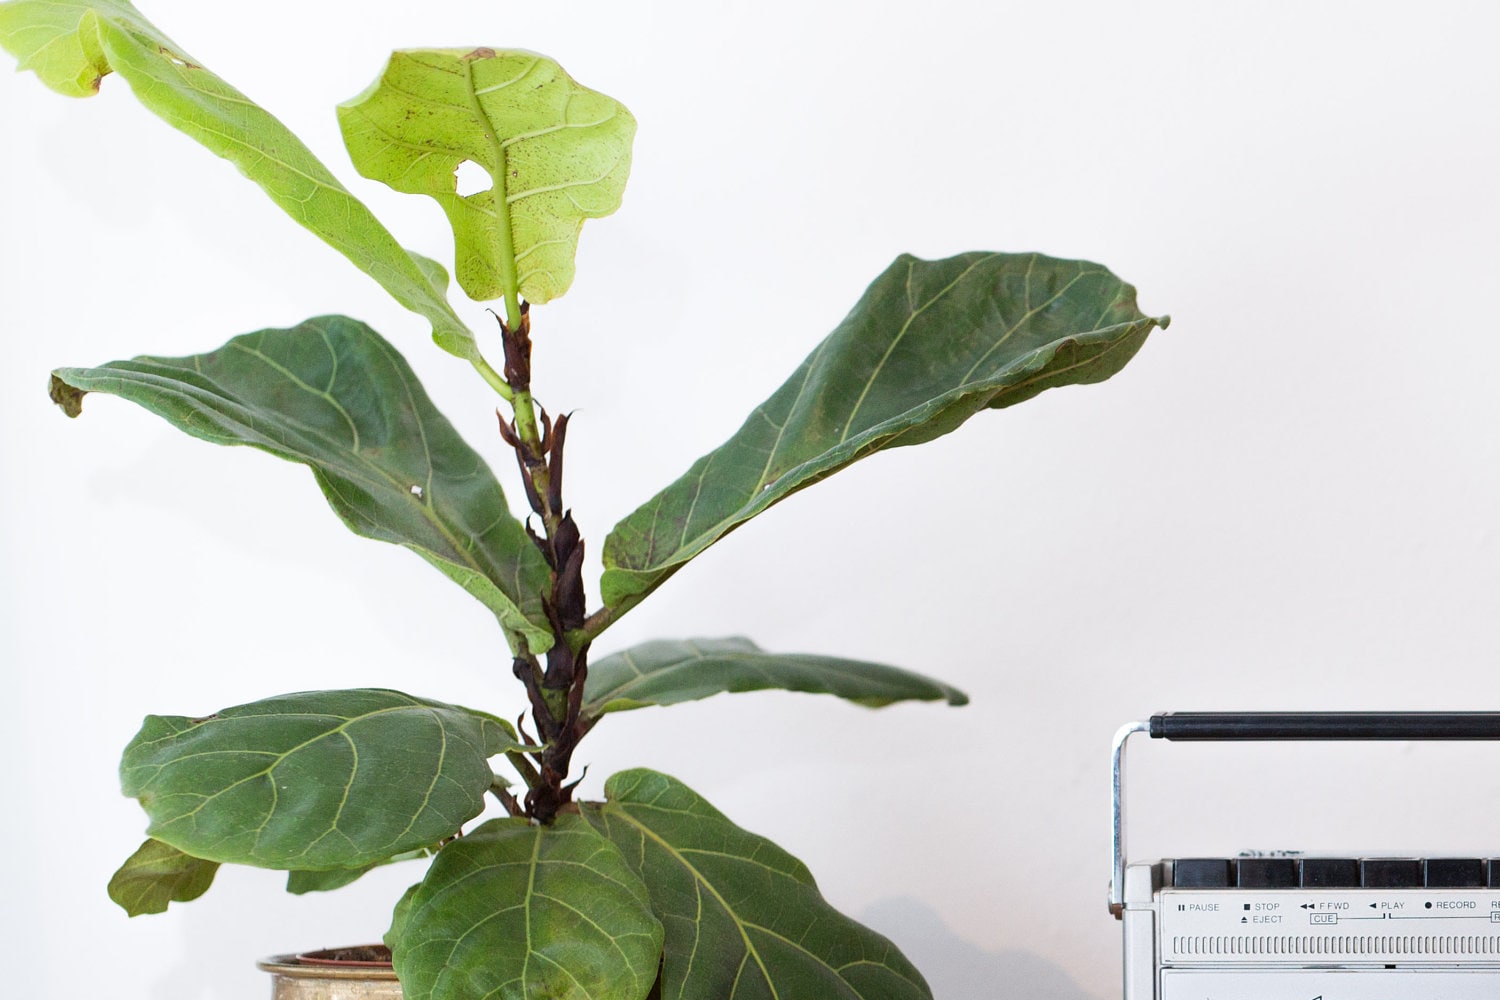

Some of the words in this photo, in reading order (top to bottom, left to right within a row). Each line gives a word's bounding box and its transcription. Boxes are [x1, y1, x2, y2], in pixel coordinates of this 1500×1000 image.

[1189, 903, 1220, 912] PAUSE
[1254, 903, 1280, 911] STOP
[1381, 902, 1405, 910] PLAY
[1436, 901, 1477, 909] RECORD
[1252, 915, 1283, 924] EJECT
[1313, 915, 1334, 923] CUE
